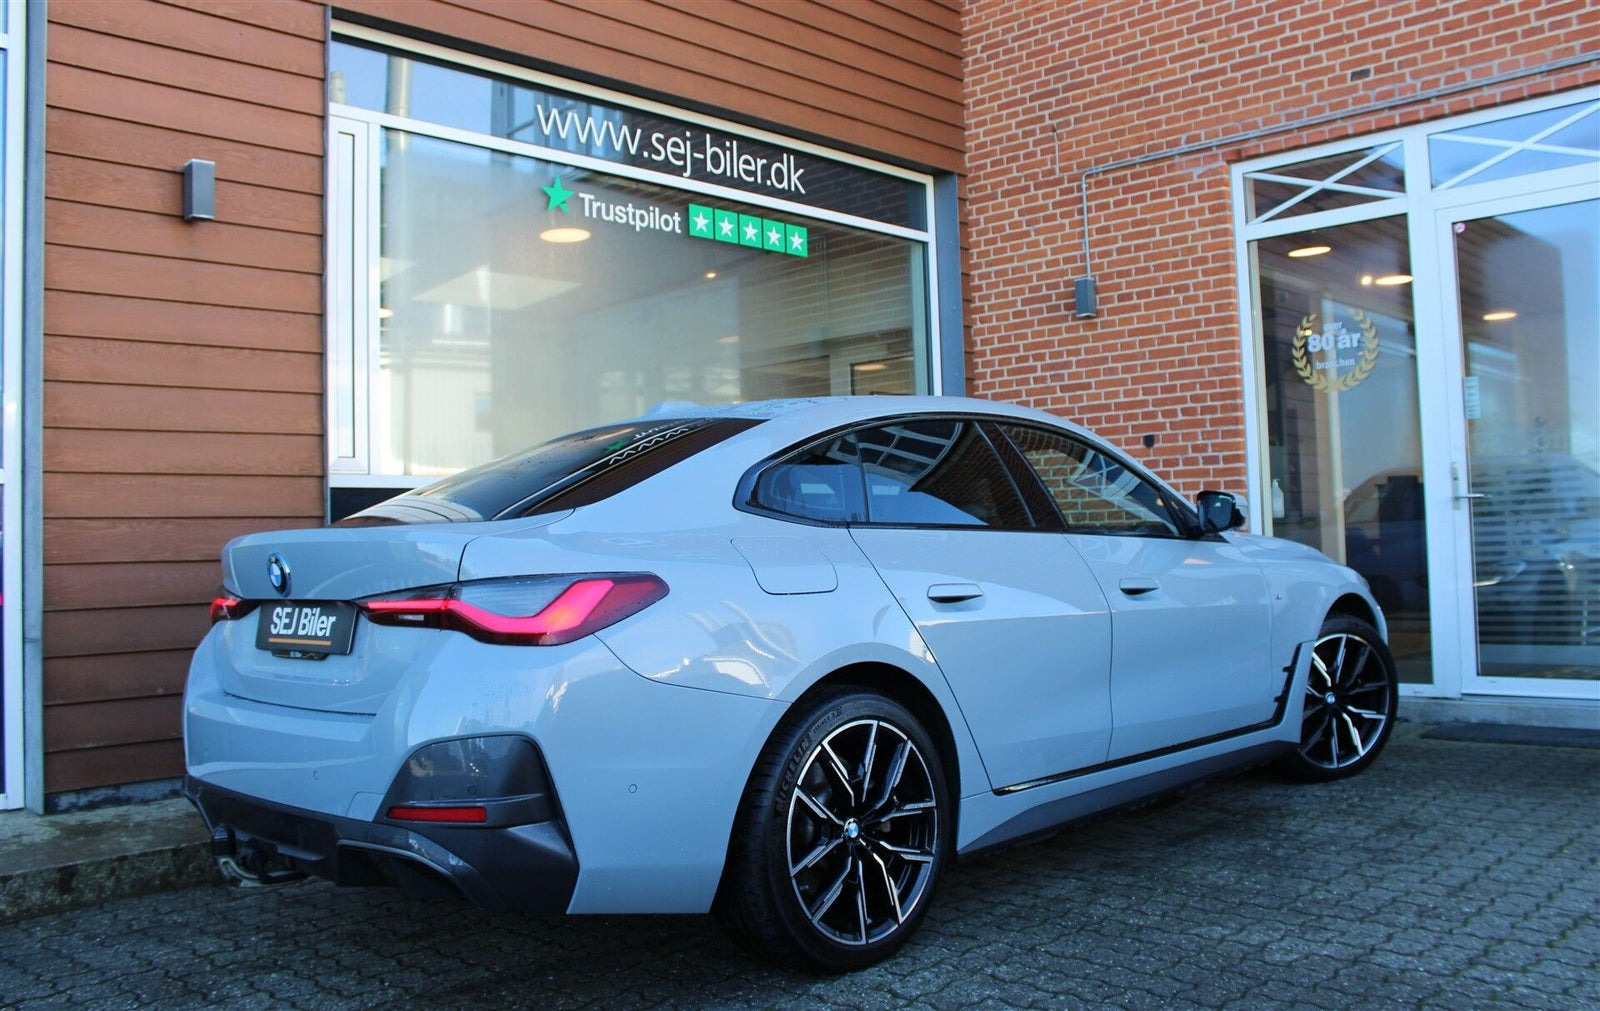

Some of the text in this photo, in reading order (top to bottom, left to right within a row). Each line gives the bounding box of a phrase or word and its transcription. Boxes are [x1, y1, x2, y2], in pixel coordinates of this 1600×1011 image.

[536, 103, 807, 194] www.sej-biler.dk
[579, 192, 682, 233] Trustpilot
[1308, 332, 1335, 353] 80
[270, 606, 337, 637] SEJ Biler
[774, 736, 811, 812] MICHELIN
